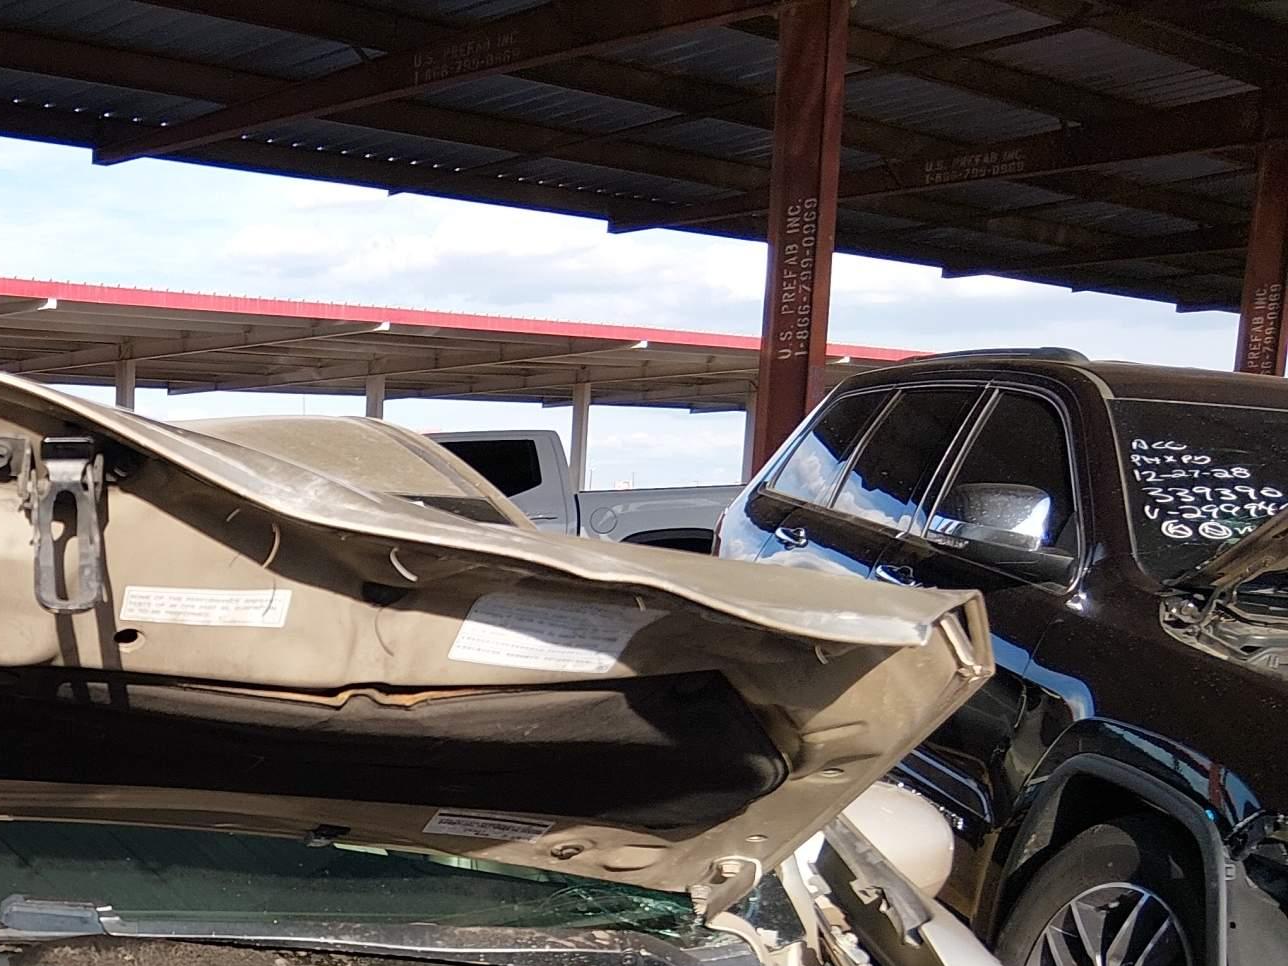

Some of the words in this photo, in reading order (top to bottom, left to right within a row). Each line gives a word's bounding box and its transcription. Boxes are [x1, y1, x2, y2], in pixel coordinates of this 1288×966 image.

[785, 199, 802, 234] INC.
[781, 243, 800, 315] PREFAB
[794, 197, 818, 357] 1-866-799-0969
[1253, 283, 1268, 310] INC.
[777, 324, 794, 359] U.S.
[1247, 316, 1265, 368] PREFAB
[1131, 438, 1187, 450] ACC
[1141, 485, 1284, 503] 339390
